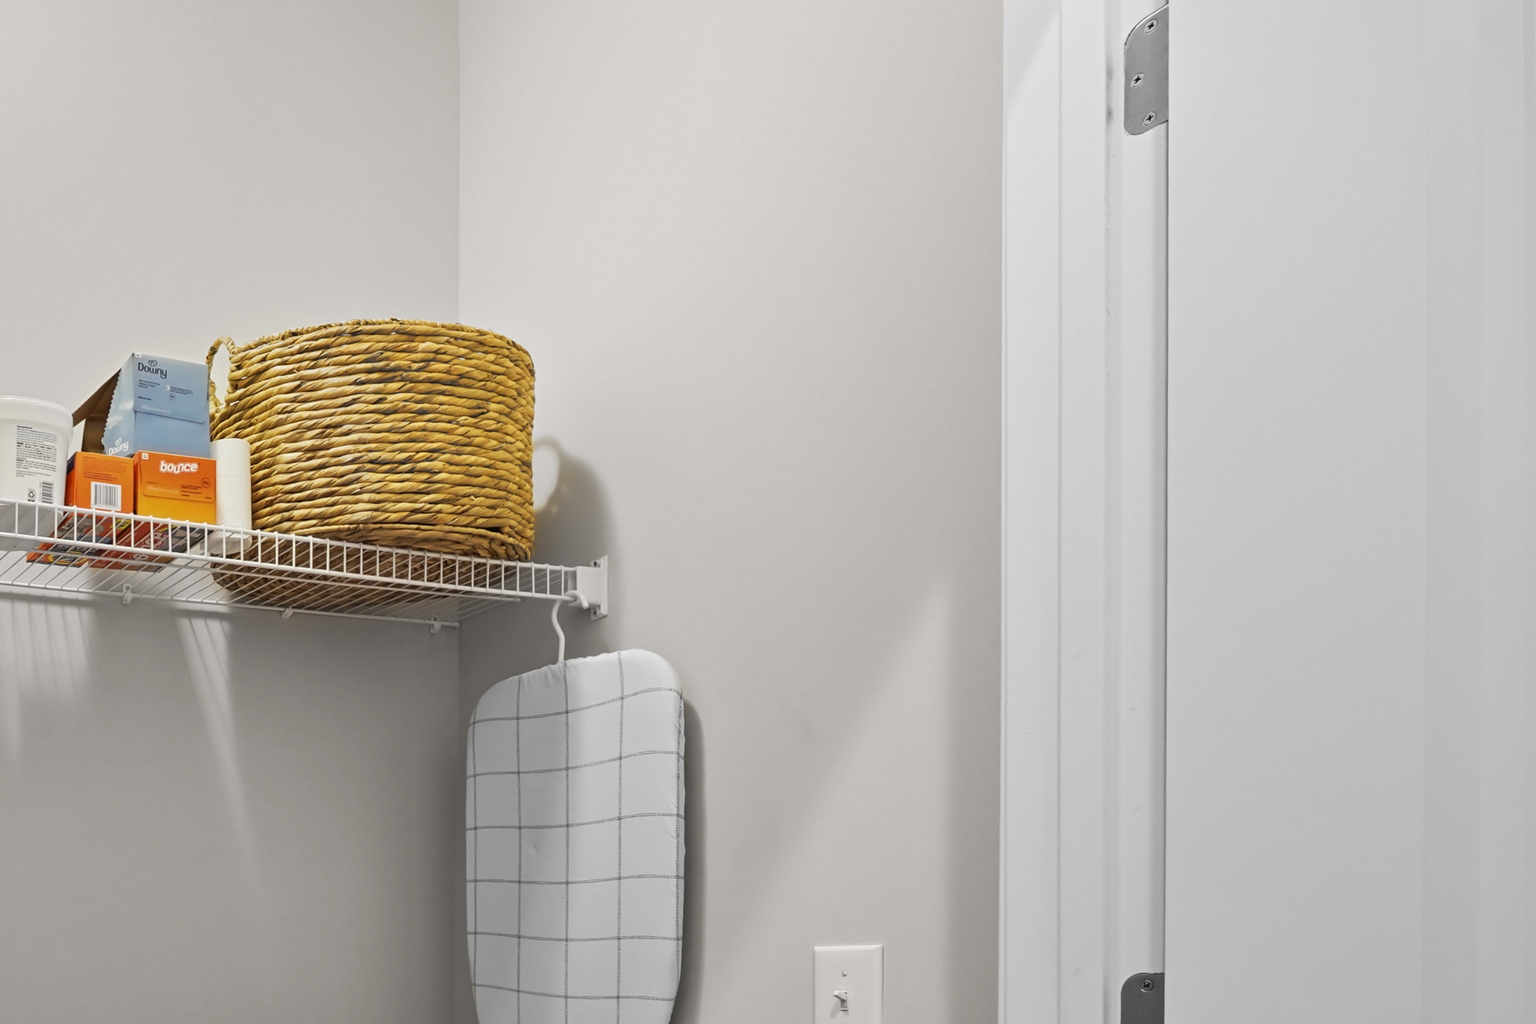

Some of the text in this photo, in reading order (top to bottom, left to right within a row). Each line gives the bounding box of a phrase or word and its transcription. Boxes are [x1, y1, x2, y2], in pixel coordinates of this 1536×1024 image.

[138, 362, 168, 380] Downy
[108, 442, 129, 456] Downy
[160, 460, 198, 474] bounce
